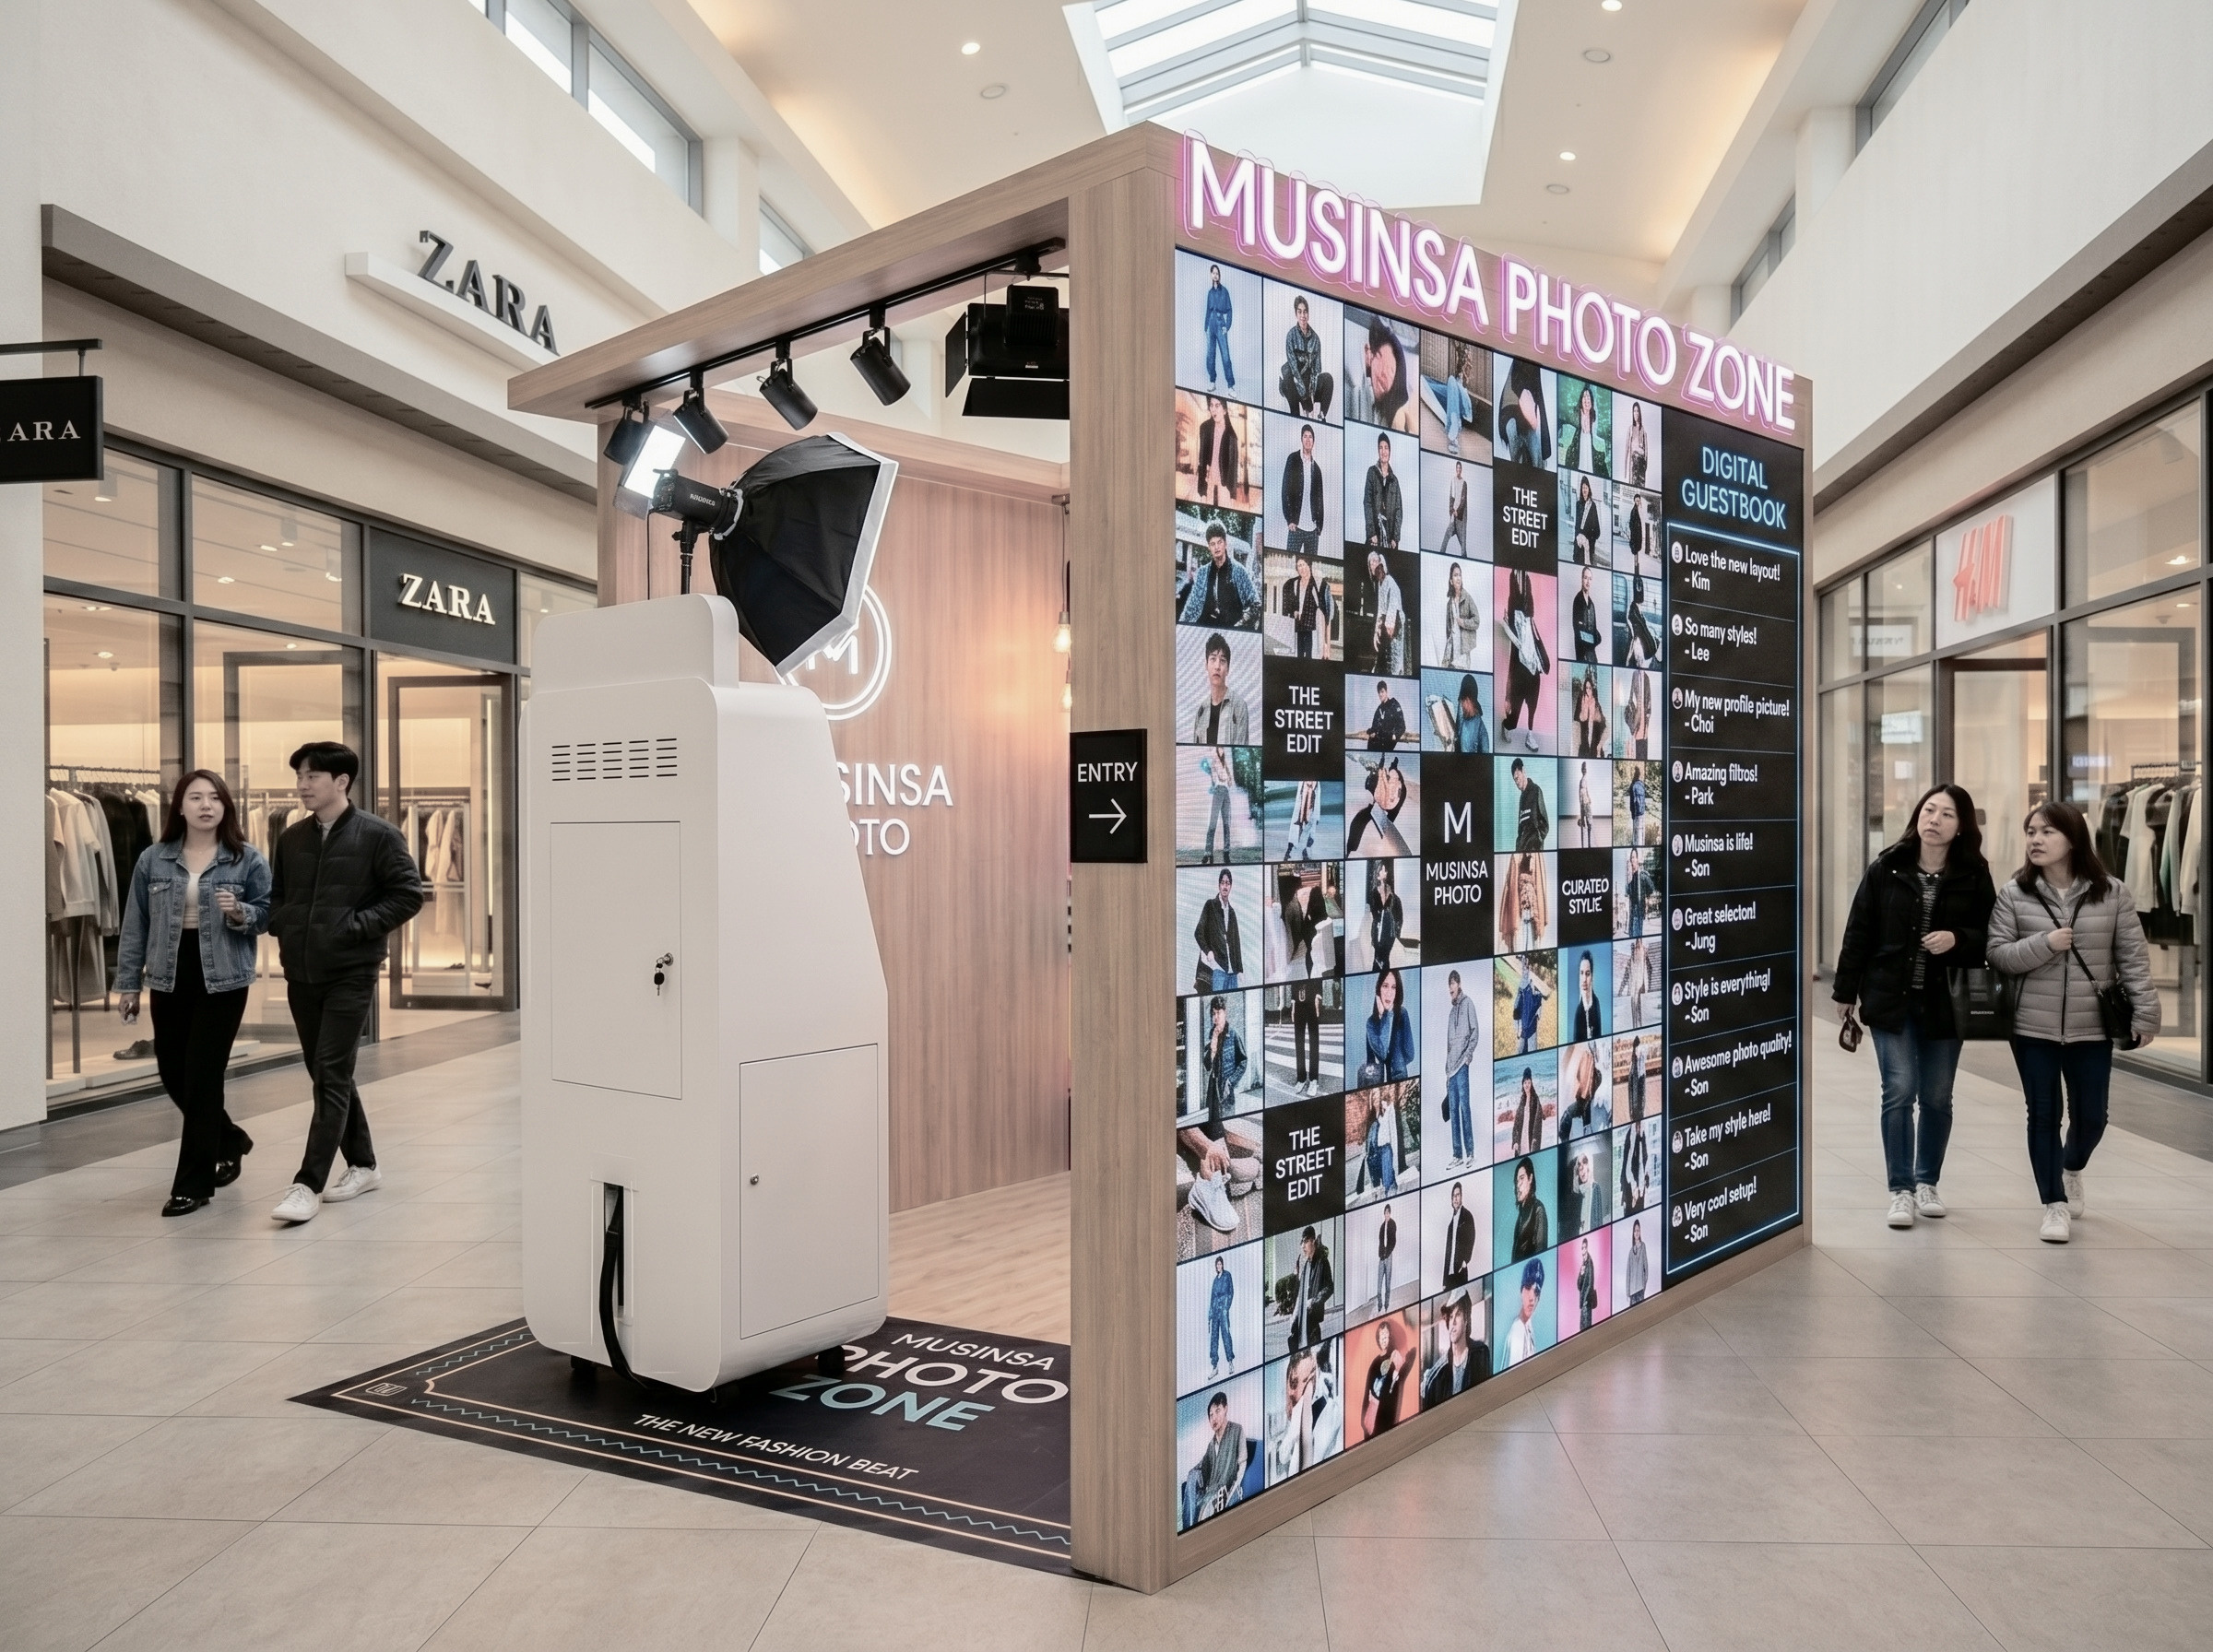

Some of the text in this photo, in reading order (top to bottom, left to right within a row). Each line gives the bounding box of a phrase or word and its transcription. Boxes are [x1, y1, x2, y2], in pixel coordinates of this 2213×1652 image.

[418, 230, 561, 357] ZARA
[1188, 136, 1796, 431] MUSINSA PHOTO ZONE
[0, 419, 81, 442] ARA
[1702, 446, 1769, 490] DIGITAL
[1512, 486, 1538, 508] THE
[1681, 478, 1787, 530] GUESTBOOK
[1502, 505, 1548, 530] STREET
[1511, 527, 1540, 549] EDIT
[1685, 545, 1781, 583] Love the new layout!
[398, 572, 496, 625] ZARA
[1685, 617, 1757, 647] So many styles!
[1288, 685, 1320, 706] THE
[1685, 689, 1790, 719] My new profile picture!
[1274, 708, 1334, 731] STREET
[1286, 734, 1322, 753] EDIT
[1077, 761, 1138, 782] ENTRY
[1685, 761, 1727, 786] Amazing
[1443, 801, 1472, 844] M
[1685, 832, 1753, 853] Musinsa is life!
[1426, 860, 1488, 881] MUSINSA
[1434, 885, 1482, 905] PHOTO
[1685, 907, 1713, 926] Great
[1685, 978, 1709, 1005] Style
[1710, 977, 1719, 995] is
[1685, 1050, 1731, 1074] Awesome
[1733, 1042, 1758, 1068] photo
[1288, 1126, 1320, 1150] THE
[1685, 1103, 1771, 1148] Take my style here!
[1275, 1146, 1335, 1179] STREET
[1287, 1174, 1322, 1201] EDIT
[1685, 1200, 1706, 1221] Very
[1729, 1175, 1757, 1201] setup!
[890, 1333, 1056, 1371] MUSINSA
[768, 1374, 996, 1431] ZONE
[633, 1414, 919, 1480] THE NEW FASHION BEAT
